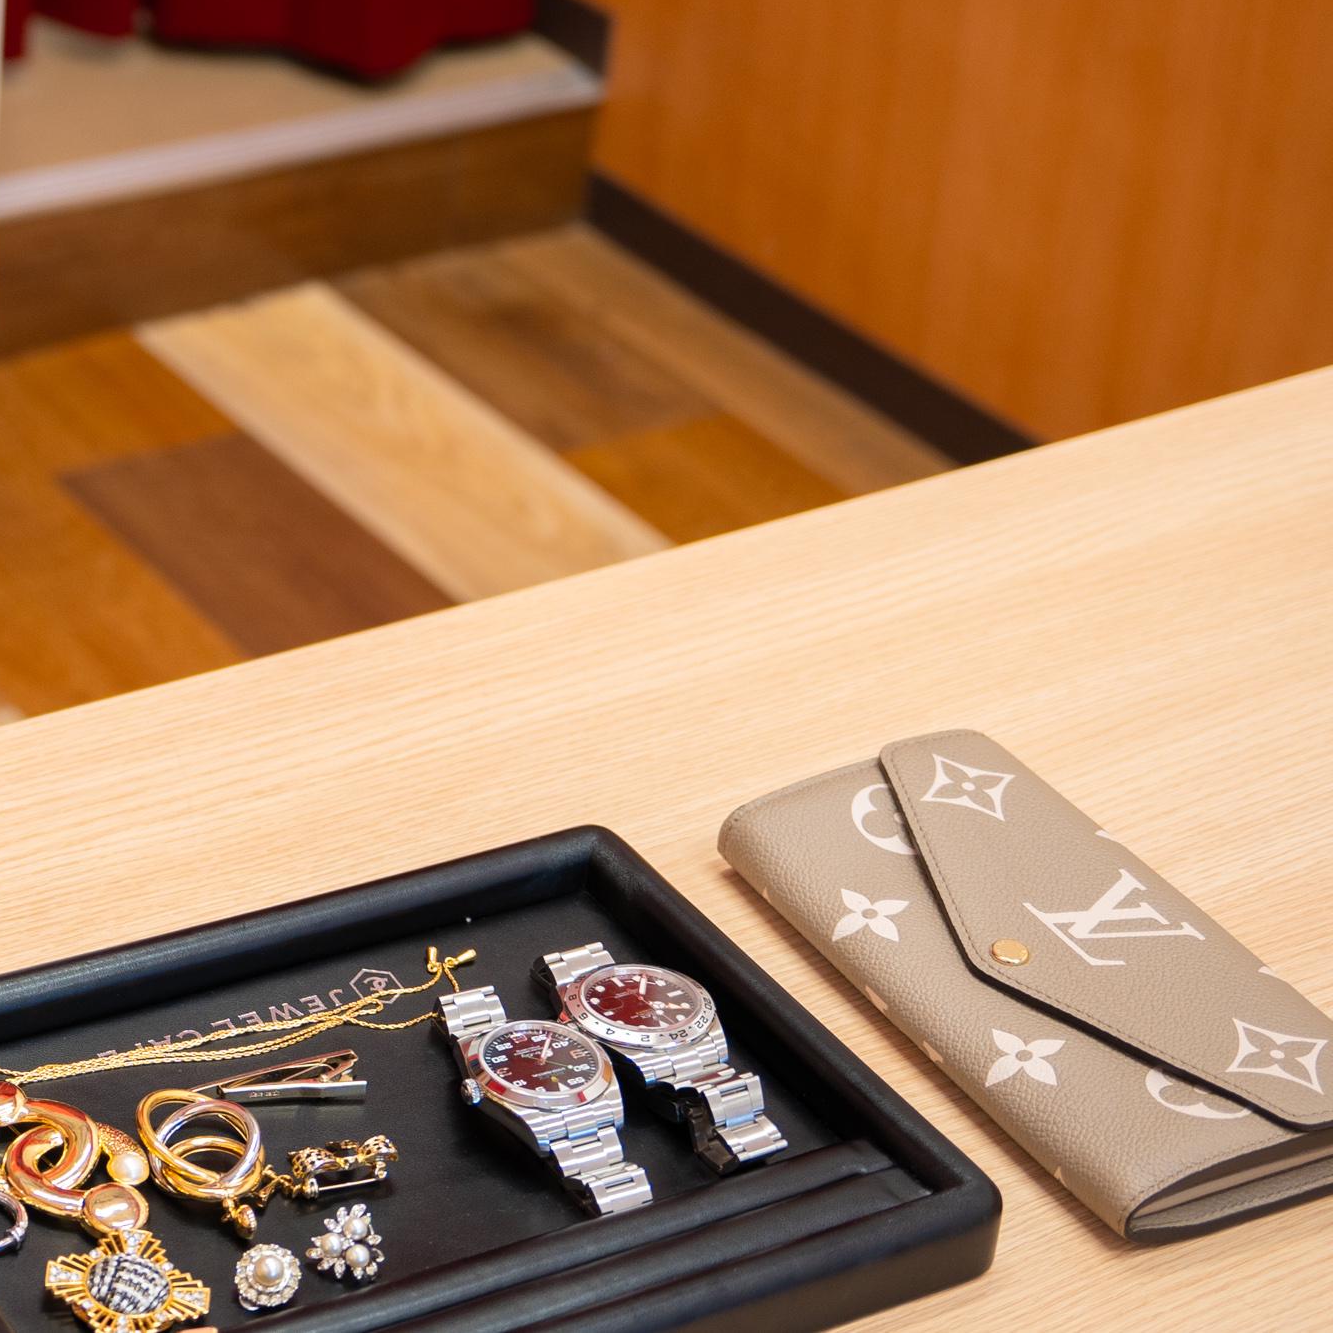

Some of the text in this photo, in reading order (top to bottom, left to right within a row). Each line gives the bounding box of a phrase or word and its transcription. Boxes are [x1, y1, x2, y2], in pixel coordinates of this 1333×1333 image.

[695, 1016, 709, 1030] 22
[640, 1034, 651, 1042] 2
[669, 1029, 689, 1040] 24
[495, 1042, 513, 1051] 25
[551, 1040, 569, 1049] 40
[491, 1055, 508, 1063] 20
[573, 1064, 590, 1072] 50
[513, 1079, 527, 1087] 10
[567, 1077, 585, 1085] 55
